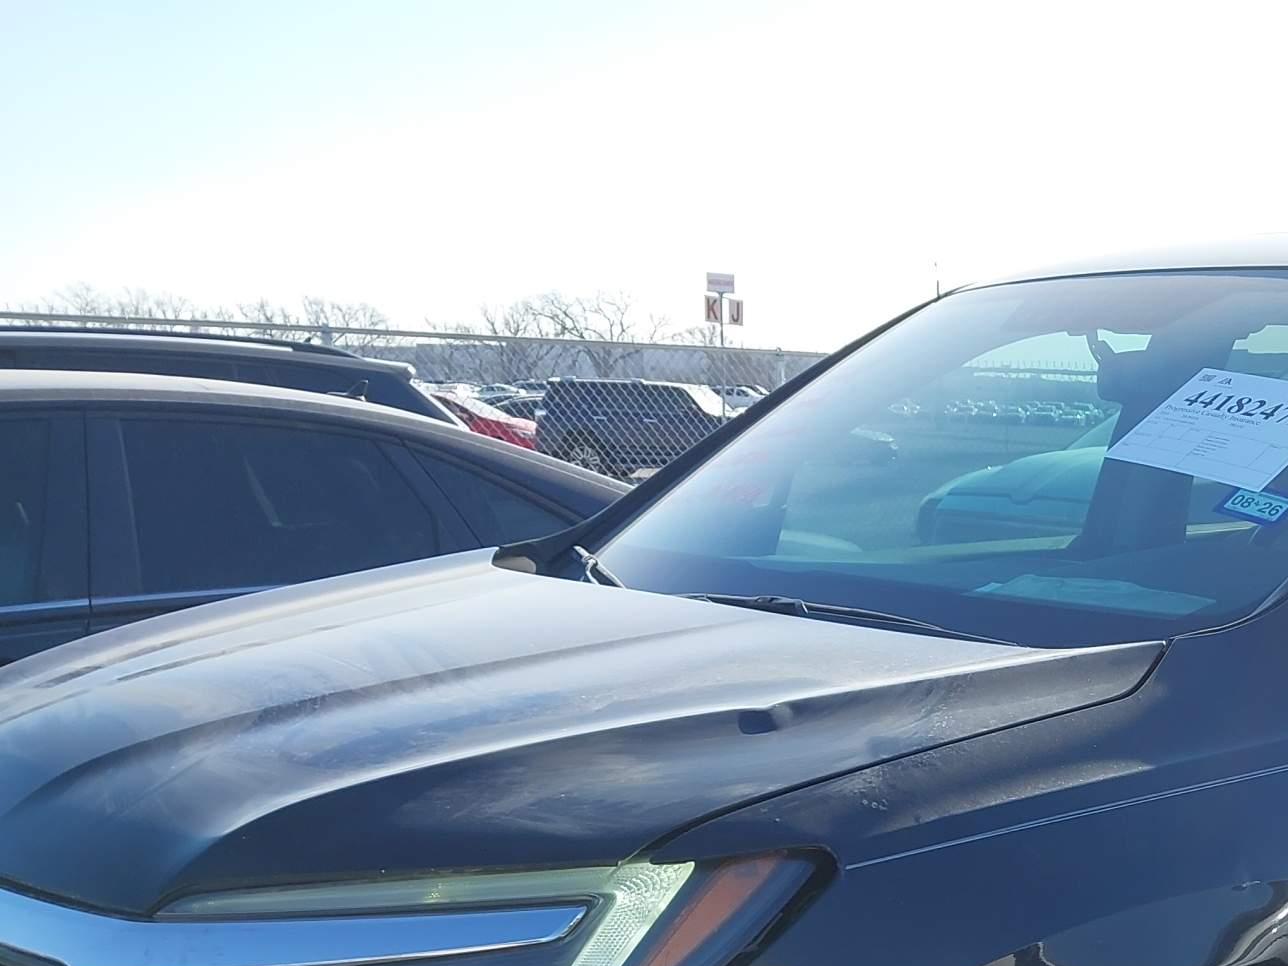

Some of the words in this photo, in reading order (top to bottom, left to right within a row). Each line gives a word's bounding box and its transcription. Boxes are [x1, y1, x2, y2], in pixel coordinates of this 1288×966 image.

[706, 298, 718, 320] K
[731, 302, 740, 322] J
[1230, 494, 1256, 509] 08
[1256, 501, 1284, 517] 26
